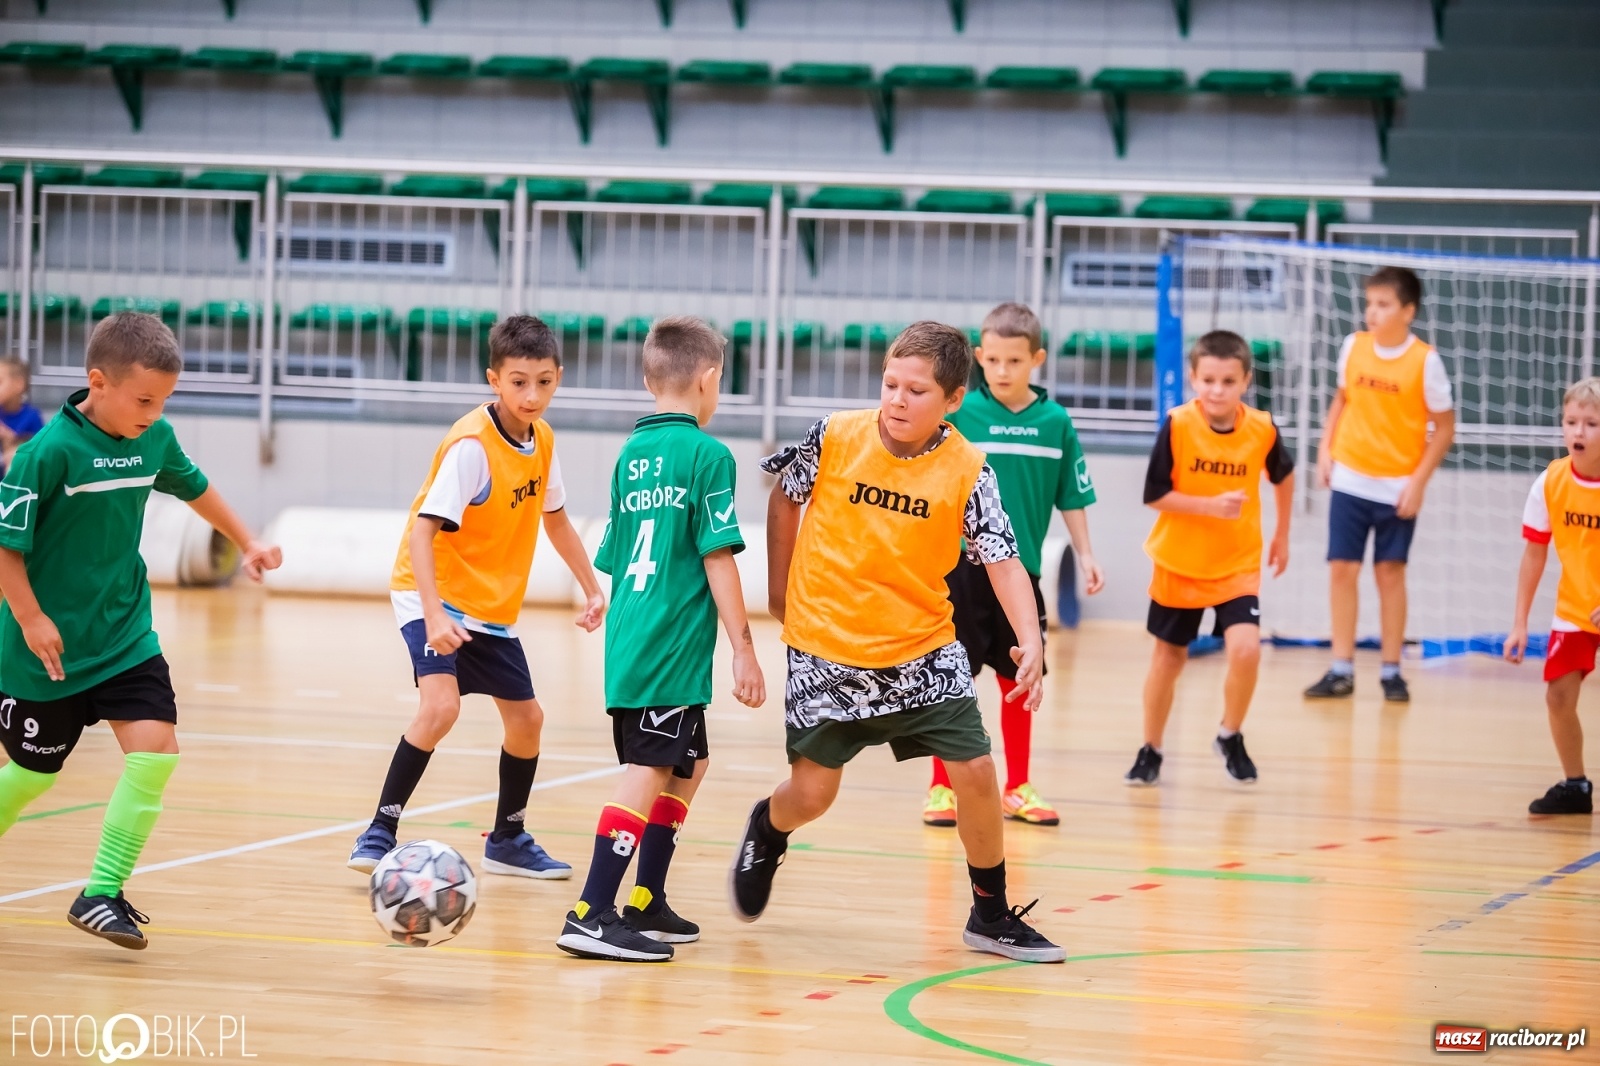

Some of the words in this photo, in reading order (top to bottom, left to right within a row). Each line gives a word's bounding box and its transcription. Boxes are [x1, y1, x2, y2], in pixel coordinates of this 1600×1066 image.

[988, 425, 1039, 436] GIVOVA
[93, 456, 143, 468] GIVOVA
[628, 459, 650, 481] SP
[653, 456, 663, 477] 3
[1189, 457, 1248, 476] Joma
[849, 482, 930, 518] Joma
[1563, 511, 1600, 529] Jom
[624, 518, 657, 592] 4
[24, 717, 39, 738] 9
[612, 830, 637, 857] 8
